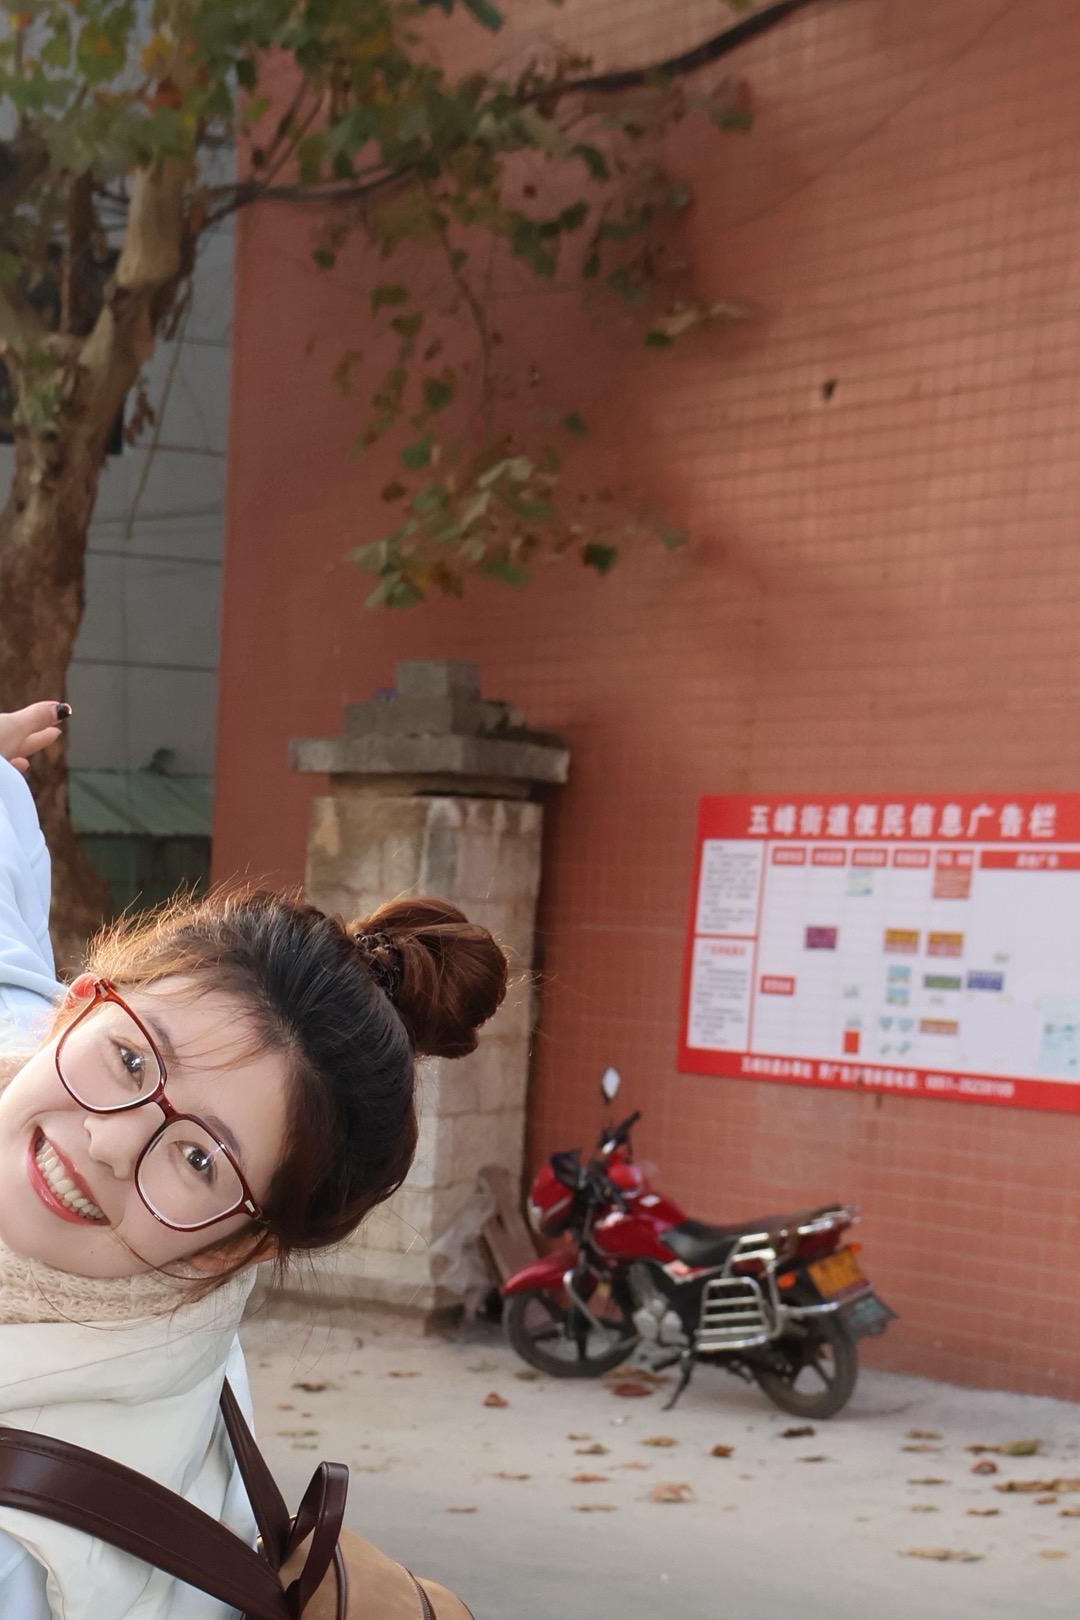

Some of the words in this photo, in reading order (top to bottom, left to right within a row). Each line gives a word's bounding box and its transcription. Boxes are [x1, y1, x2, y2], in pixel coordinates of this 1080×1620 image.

[748, 803, 1057, 838] 五峰街道便民信息广告栏
